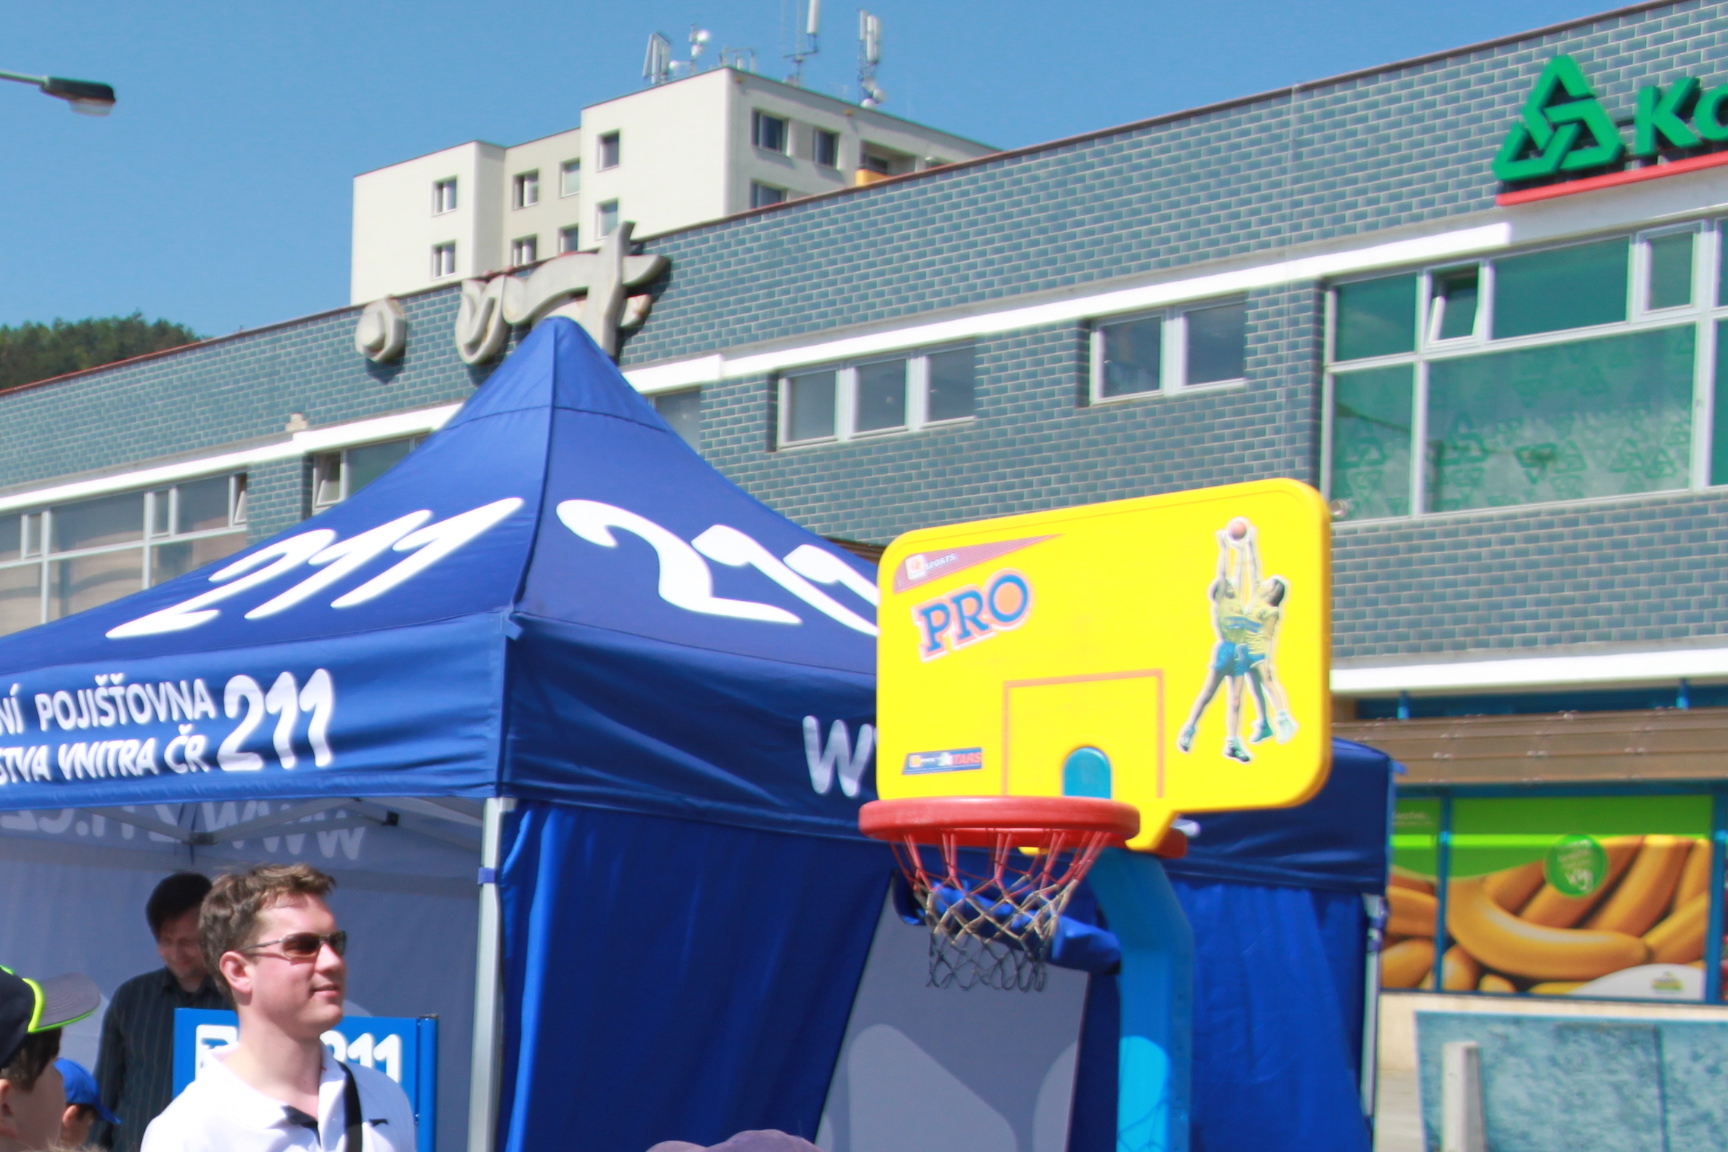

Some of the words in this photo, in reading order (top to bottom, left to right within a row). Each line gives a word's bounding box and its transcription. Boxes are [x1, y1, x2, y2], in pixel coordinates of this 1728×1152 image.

[105, 497, 524, 639] 211
[924, 553, 956, 570] SPORTS
[915, 570, 1032, 658] PRO
[35, 673, 217, 732] POJIŠŤOVNA
[217, 668, 334, 771] 211
[58, 738, 159, 780] VNITRA
[164, 724, 210, 774] ČR
